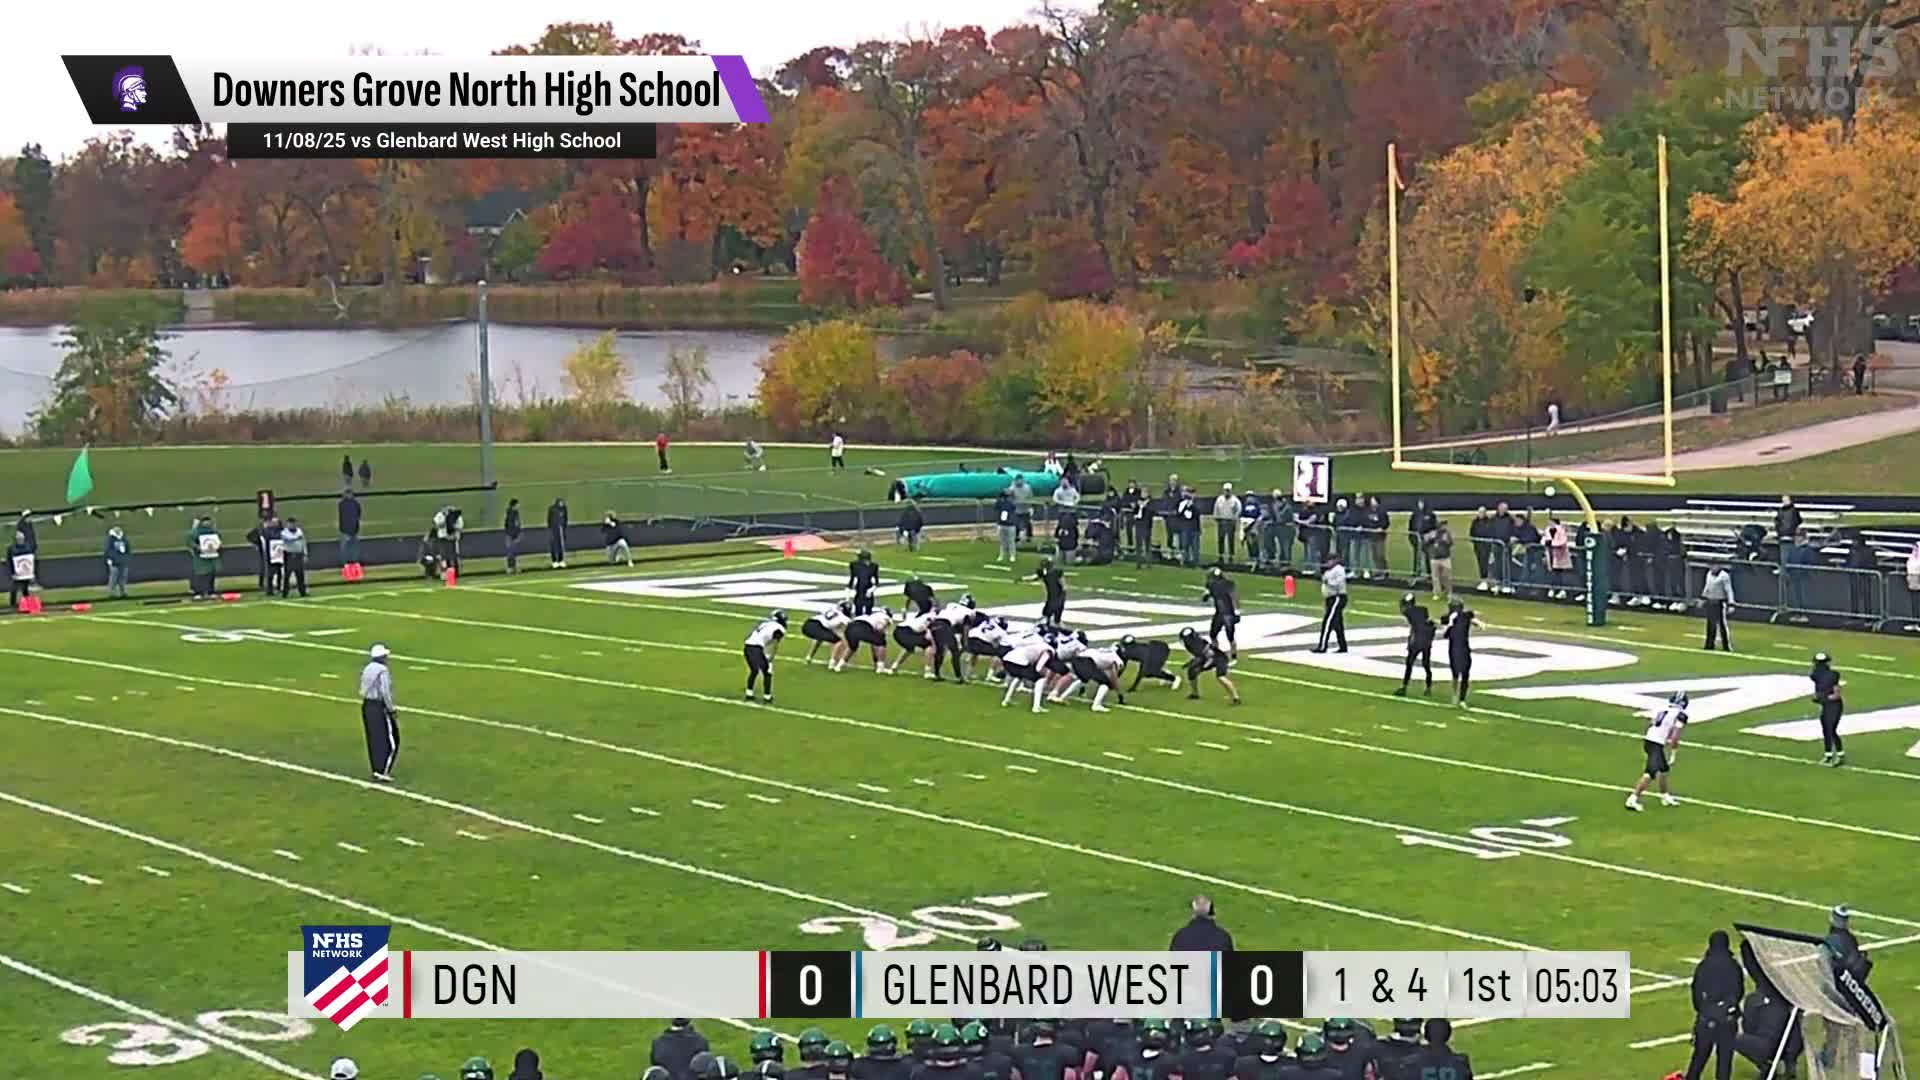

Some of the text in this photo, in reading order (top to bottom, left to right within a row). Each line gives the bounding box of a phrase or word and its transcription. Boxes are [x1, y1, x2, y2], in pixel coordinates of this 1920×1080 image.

[1395, 824, 1574, 860] 10
[797, 904, 1021, 951] 20
[59, 1008, 316, 1067] 30
